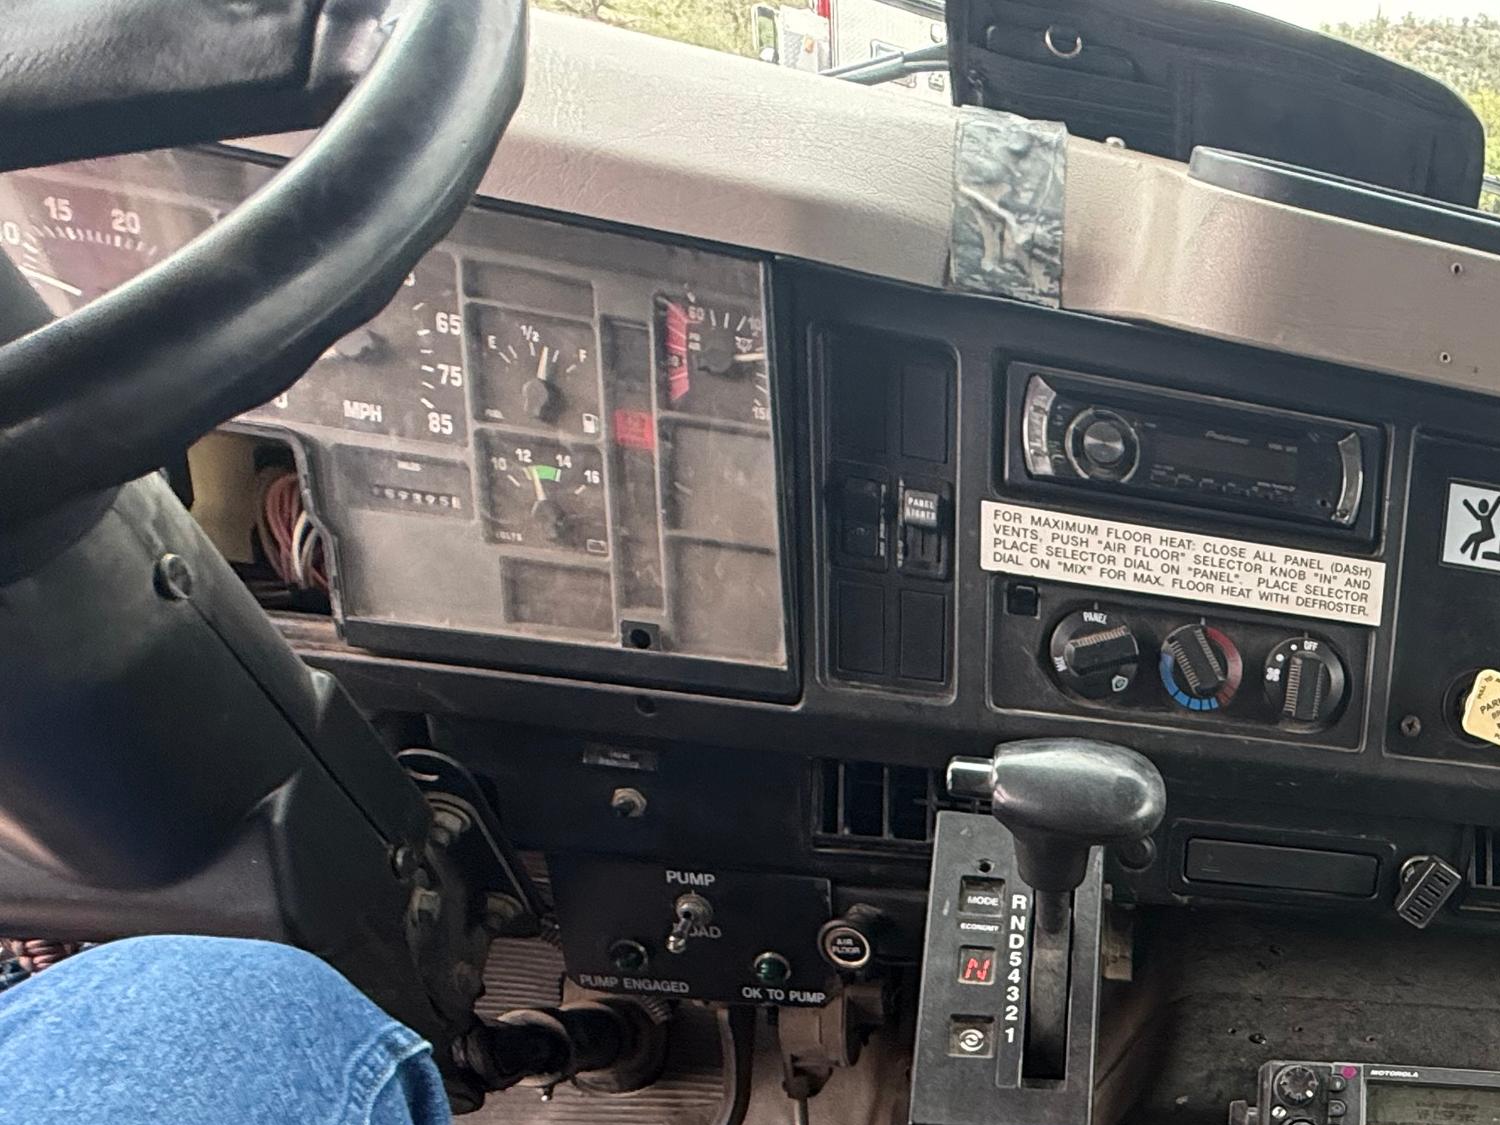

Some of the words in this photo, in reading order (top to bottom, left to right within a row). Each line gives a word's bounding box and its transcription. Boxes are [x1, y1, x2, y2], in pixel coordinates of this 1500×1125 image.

[44, 196, 73, 222] 15
[111, 208, 141, 235] 20
[0, 221, 20, 245] 0
[435, 312, 462, 335] 65
[520, 324, 540, 343] 1/2
[488, 335, 497, 349] E
[578, 349, 587, 363] F
[436, 364, 463, 387] 75
[342, 399, 382, 423] MPH
[427, 412, 453, 435] 85
[492, 456, 507, 472] 10
[515, 448, 533, 464] 12
[555, 454, 573, 469] 14
[583, 469, 601, 484] 16
[908, 496, 934, 510] PANEL
[993, 509, 1022, 524] FOR
[1030, 515, 1099, 536] MAXIMUM
[1106, 527, 1152, 544] FLOOR
[1203, 542, 1246, 559] CLOSE
[1253, 549, 1277, 563] ALL
[1284, 554, 1324, 571] PANEL
[1330, 561, 1373, 578] (DASH)
[993, 523, 1044, 543] VENTS,
[1051, 532, 1089, 548] PUSH
[1098, 539, 1126, 554] "AIR
[1134, 546, 1186, 562] FLOOR"
[1193, 553, 1263, 574] SELECTOR
[1270, 565, 1307, 581] KNOB
[1313, 571, 1338, 585] "IN"
[1343, 577, 1371, 590] AND
[993, 537, 1038, 554] PLACE
[1045, 545, 1117, 566] SELECTOR
[1123, 557, 1153, 571] DIAL
[1160, 563, 1180, 575] ON
[1257, 577, 1298, 593] PLACE
[1304, 584, 1369, 604] SELECTOR
[993, 551, 1023, 566] DIAL
[1030, 557, 1050, 570] ON
[1057, 561, 1093, 575] "MIX"
[1100, 567, 1127, 581] FOR
[1133, 572, 1165, 587] MAX.
[1171, 578, 1214, 594] FLOOR
[1221, 585, 1253, 599] HEAT
[1258, 590, 1289, 605] WITH
[1295, 595, 1369, 617] DEFROSTER.
[1082, 611, 1108, 626] PANEL
[1303, 640, 1319, 652] OFF
[665, 870, 716, 887] PUMP
[967, 895, 1000, 907] MODE
[1011, 894, 1028, 910] R
[960, 922, 1000, 932] ECONOMY
[1010, 915, 1026, 931] N
[1008, 933, 1025, 950] D
[1008, 951, 1022, 967] 5
[964, 958, 991, 981] N
[1007, 968, 1021, 984] 4
[579, 974, 618, 988] PUMP
[623, 976, 690, 994] ENGAGED
[742, 986, 762, 1000] OK
[766, 988, 785, 1001] TO
[788, 990, 825, 1004] PUMP
[1006, 986, 1020, 1001] 3
[1004, 1005, 1019, 1021] 2
[1005, 1027, 1015, 1043] 1
[1370, 1069, 1419, 1079] MOTOROLA
